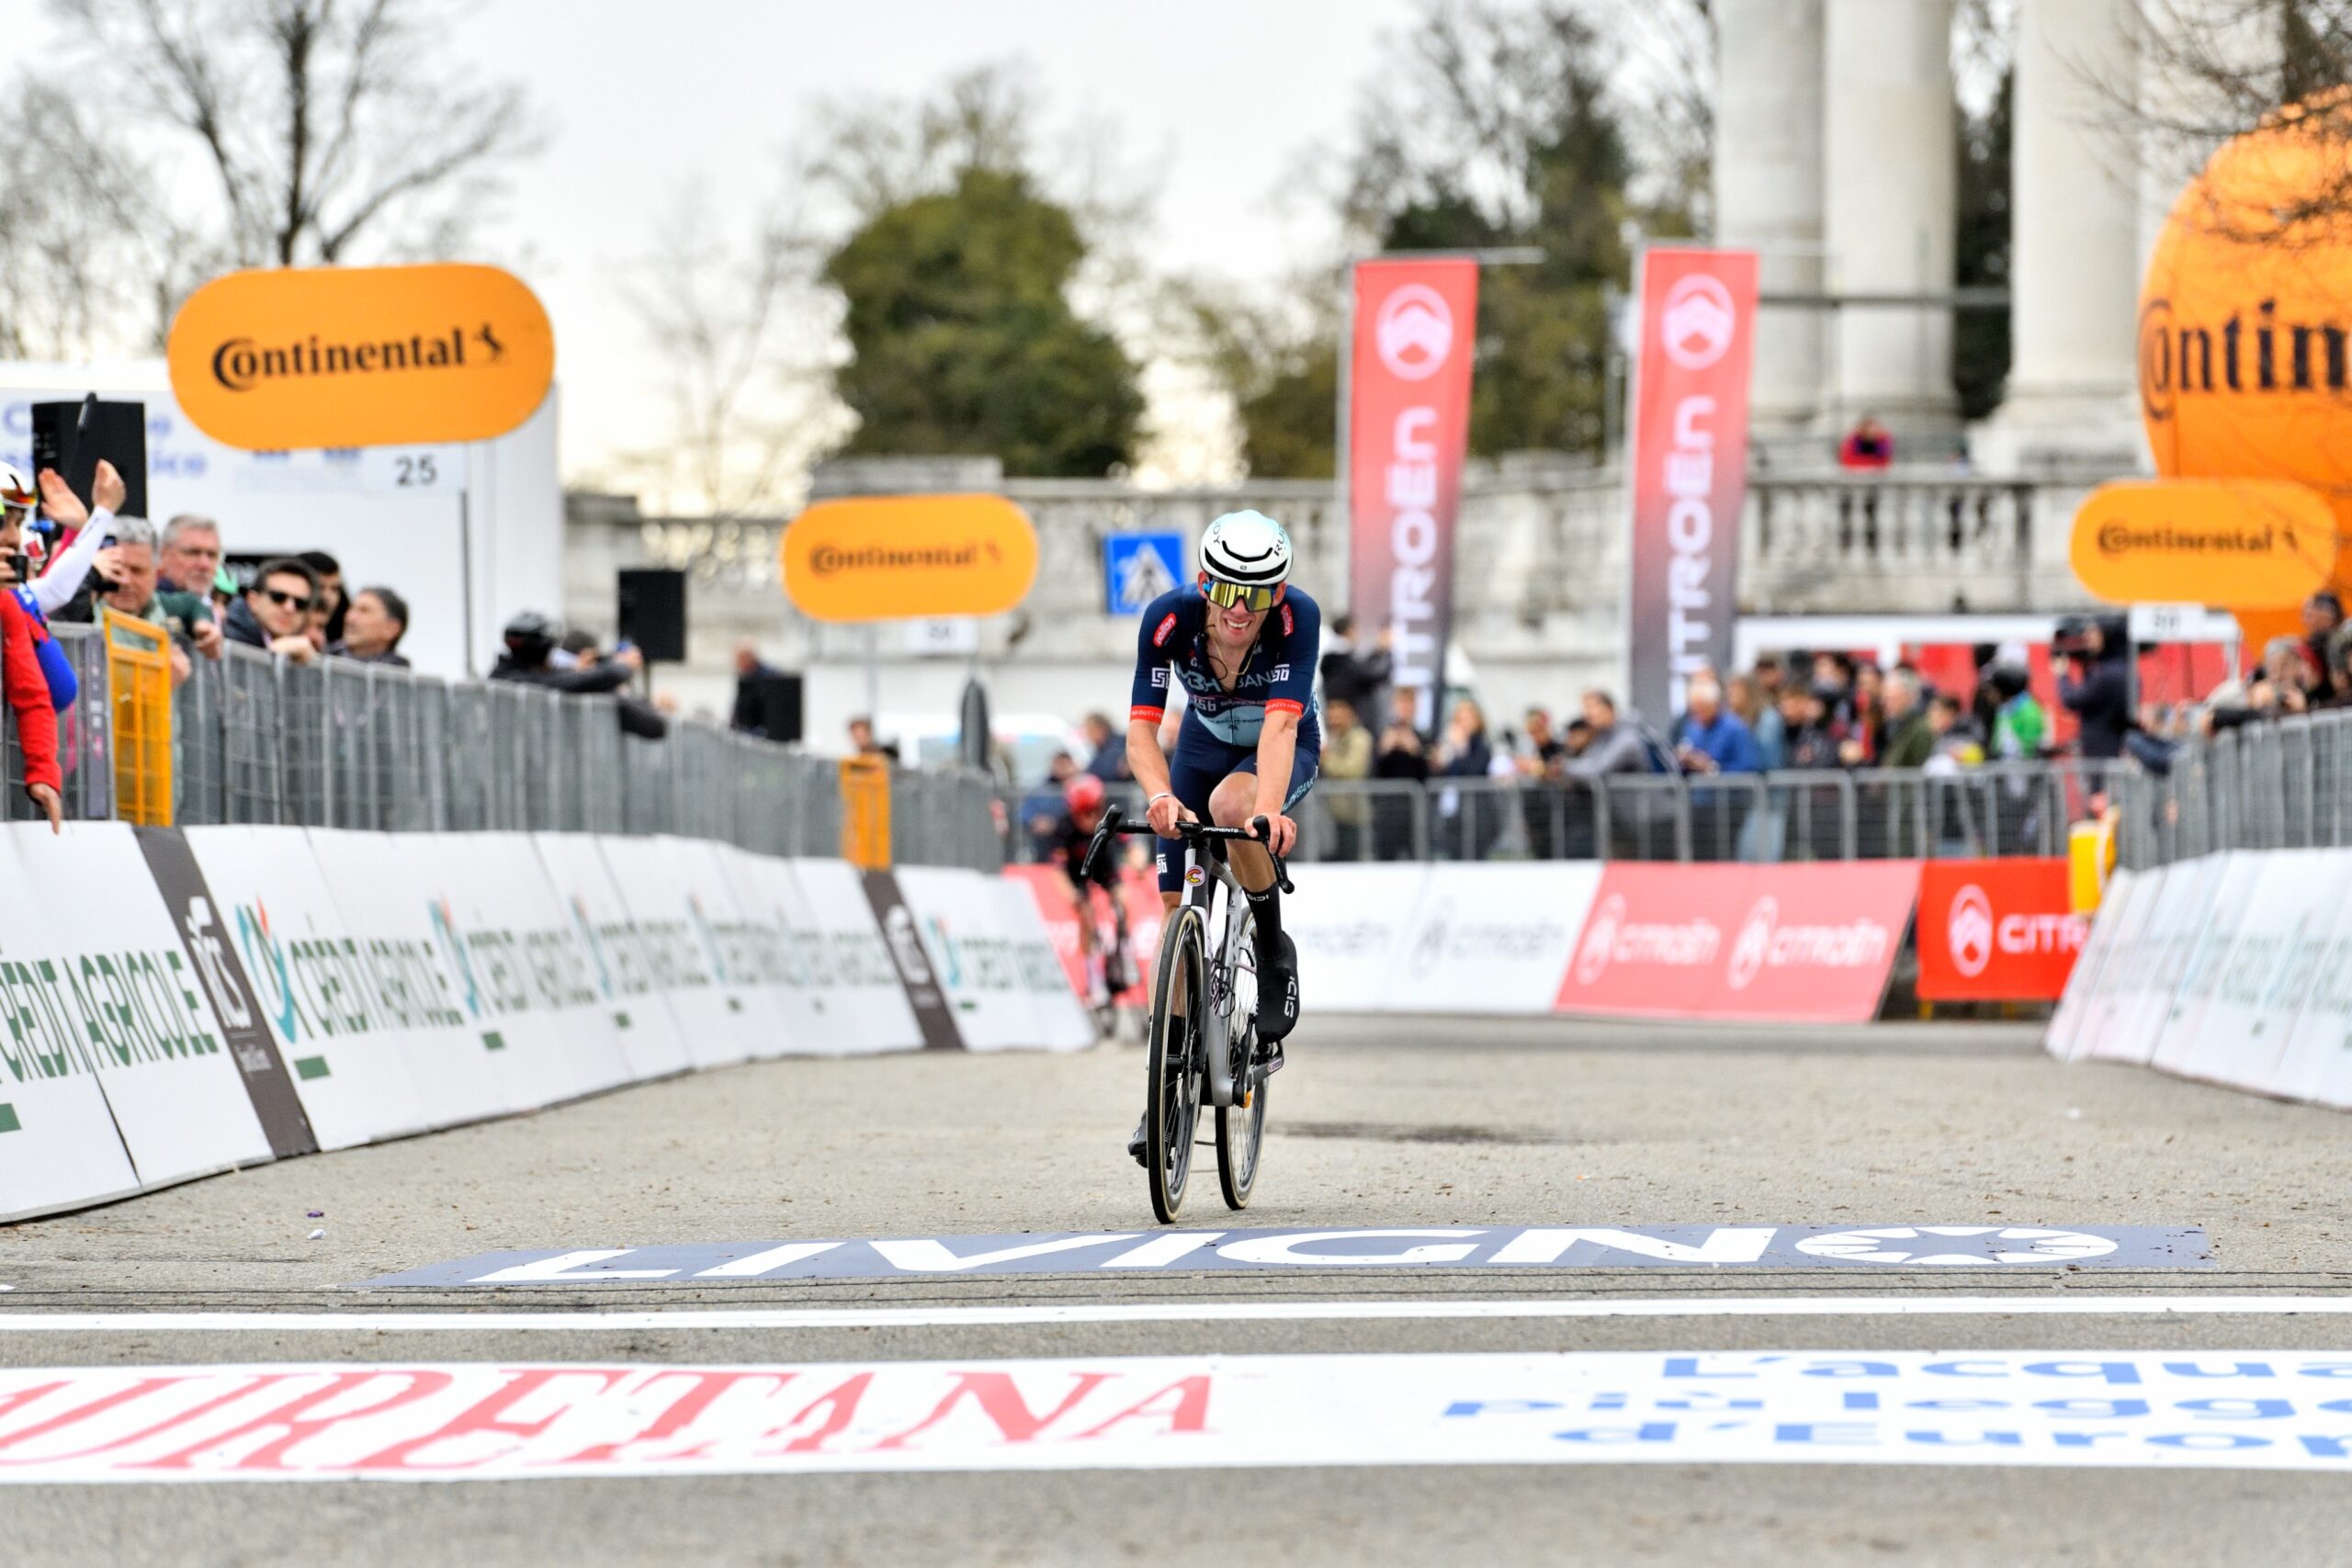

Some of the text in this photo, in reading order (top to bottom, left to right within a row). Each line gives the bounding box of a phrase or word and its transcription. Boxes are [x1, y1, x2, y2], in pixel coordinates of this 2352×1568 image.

[210, 324, 466, 393] Continental
[395, 455, 438, 488] 25
[2098, 519, 2274, 557] Continental
[1997, 913, 2088, 953] CITR
[62, 950, 220, 1072] AGRICOLE
[1283, 976, 1298, 1019] SIDI
